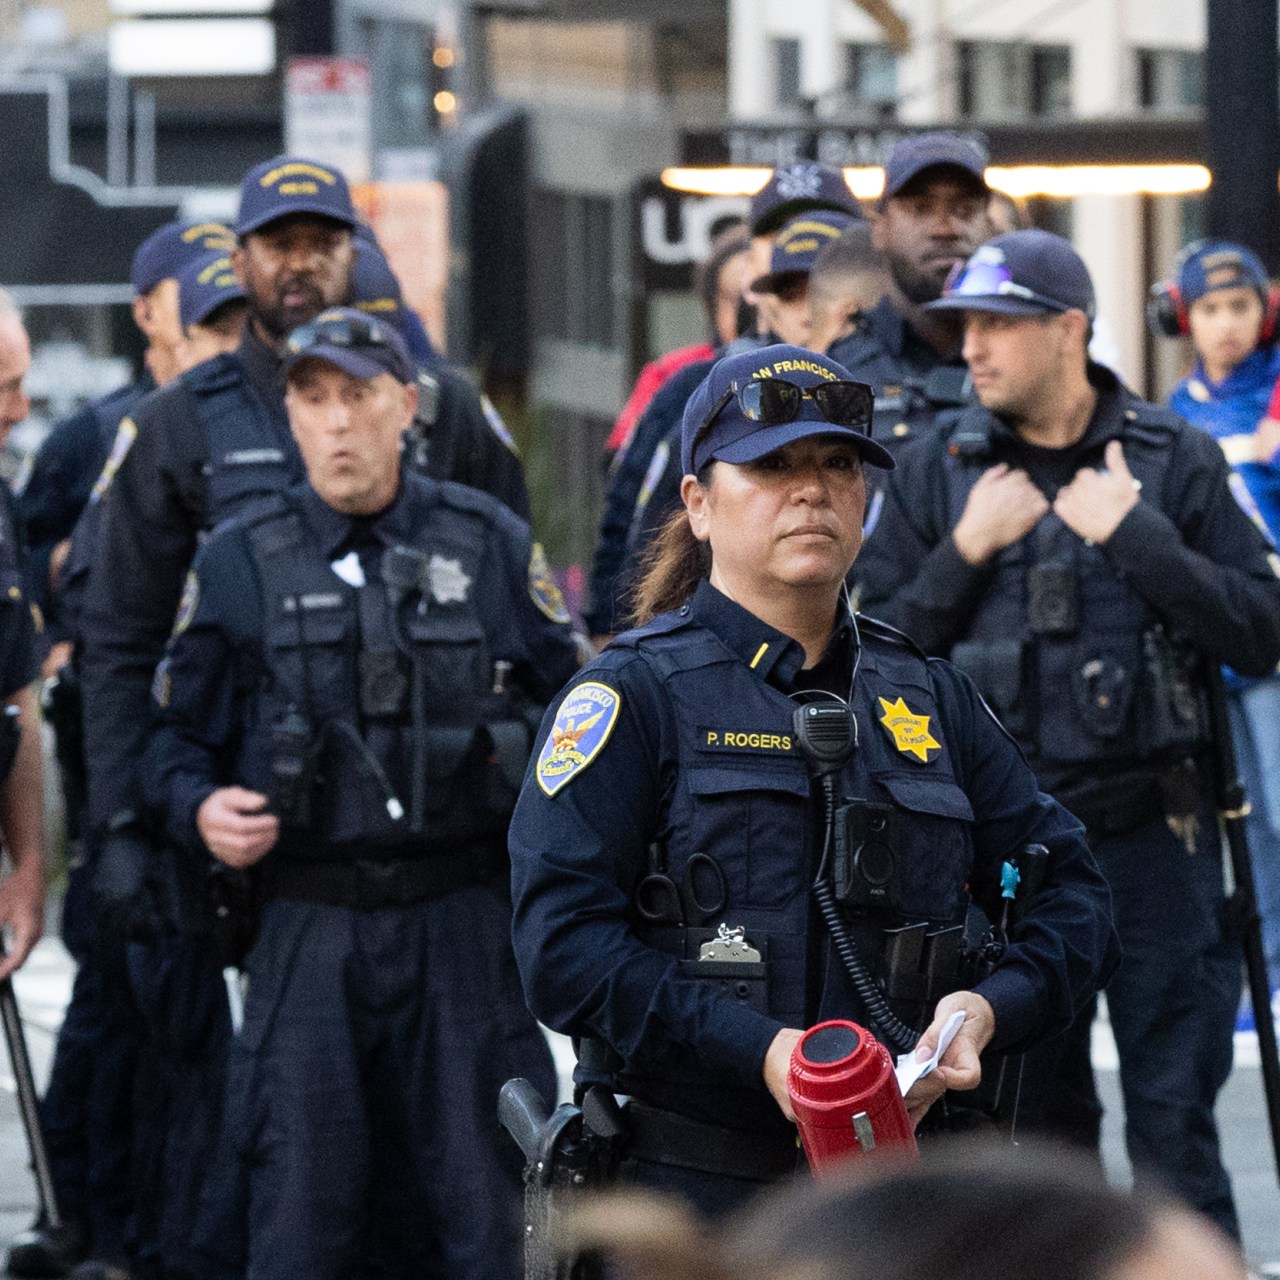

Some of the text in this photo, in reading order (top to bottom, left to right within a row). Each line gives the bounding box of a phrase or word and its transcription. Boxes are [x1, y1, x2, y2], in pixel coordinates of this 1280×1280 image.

[773, 360, 841, 382] FRANCISC
[707, 732, 792, 750] P. ROGERS
